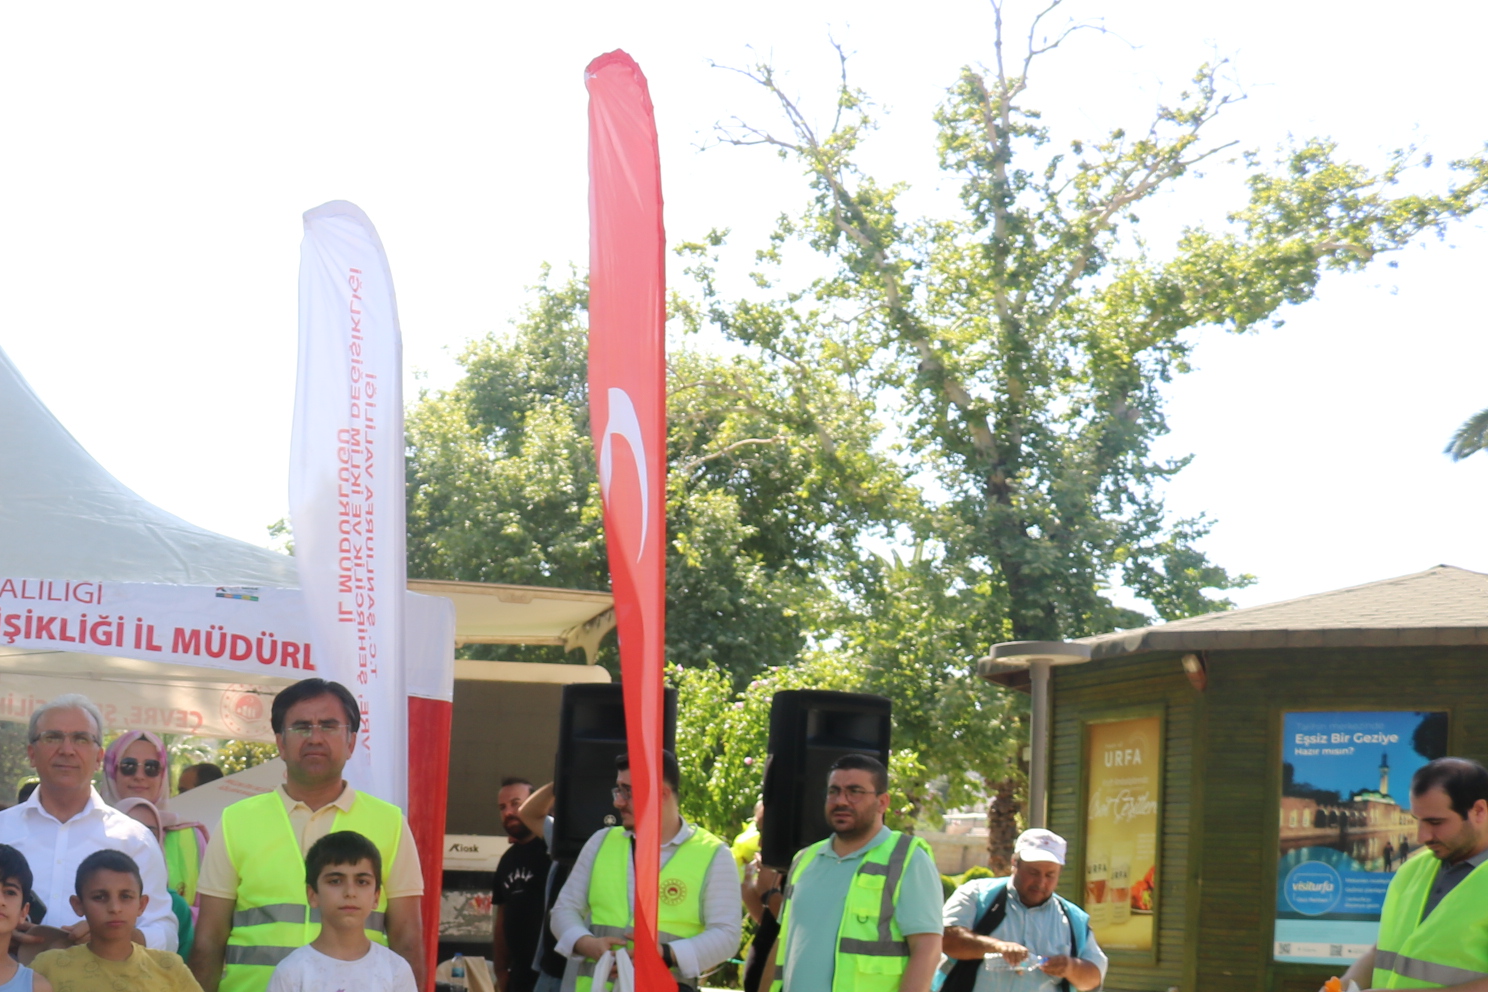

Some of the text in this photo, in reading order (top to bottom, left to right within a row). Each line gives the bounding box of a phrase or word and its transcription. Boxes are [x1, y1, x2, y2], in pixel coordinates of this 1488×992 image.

[134, 617, 162, 652] İL
[172, 625, 316, 671] MÜDÜRL
[1295, 731, 1400, 746] Eşsiz Bir Geziye
[1104, 747, 1142, 768] URFA
